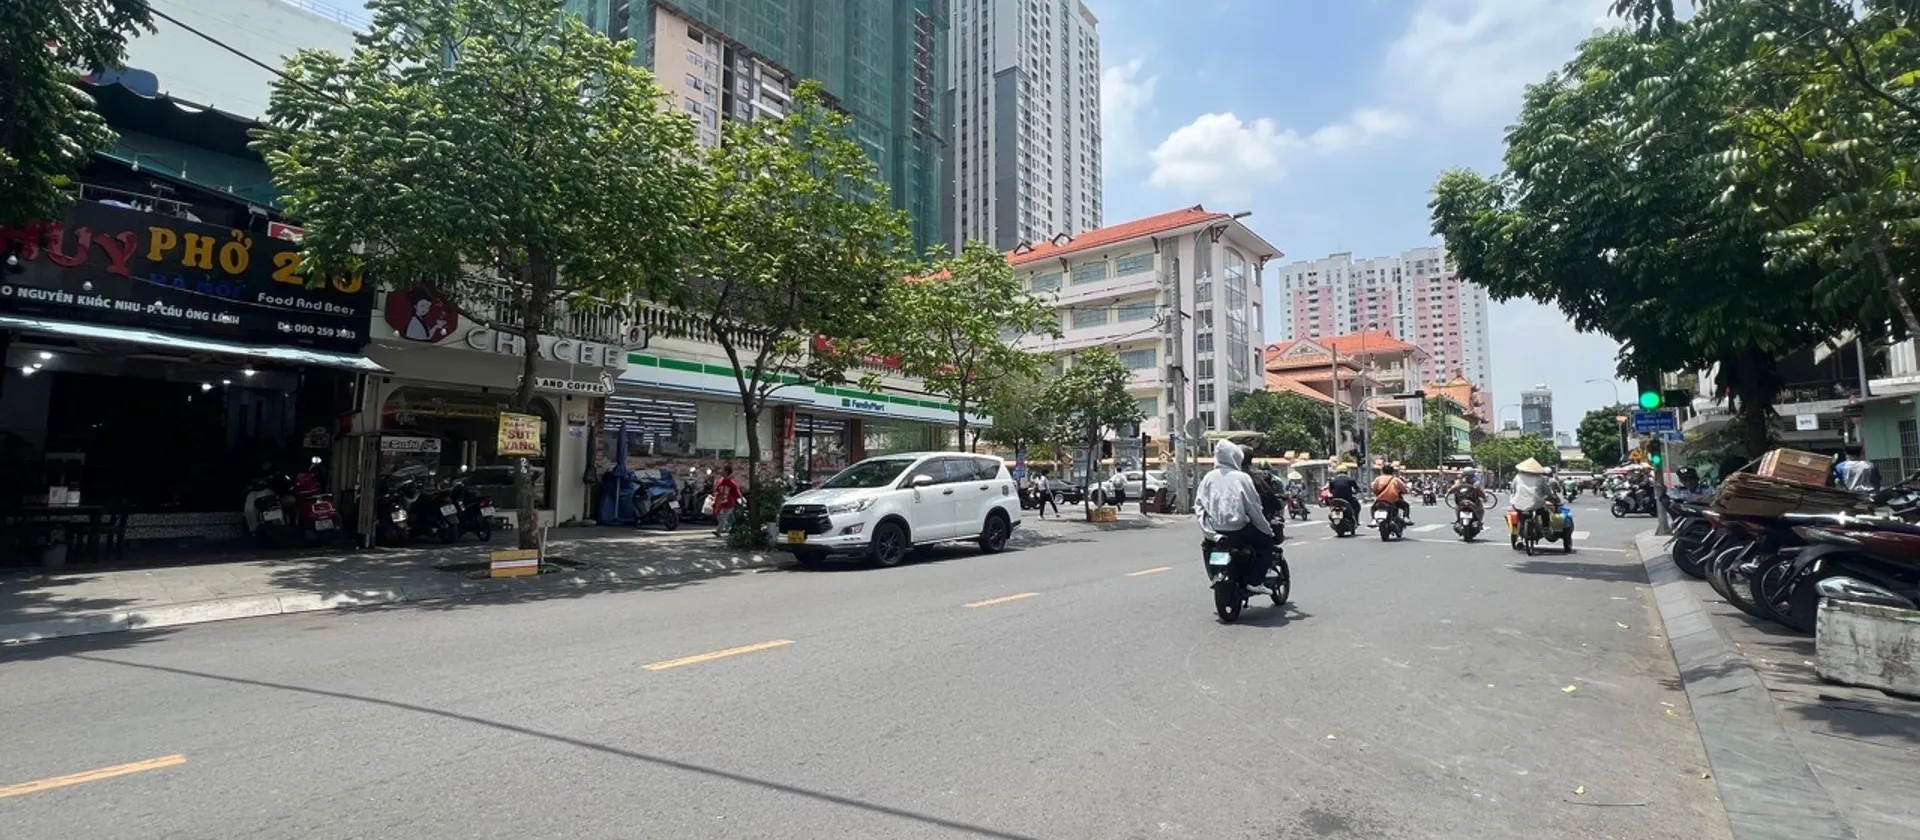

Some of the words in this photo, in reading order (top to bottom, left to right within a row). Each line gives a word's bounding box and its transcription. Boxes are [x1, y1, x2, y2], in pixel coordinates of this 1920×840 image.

[147, 226, 252, 274] PHỞ
[258, 292, 294, 306] Food
[296, 298, 322, 310] And
[324, 302, 356, 315] Beer
[186, 309, 209, 321] ÔNG
[542, 379, 564, 388] AND
[567, 381, 604, 393] COFFEE
